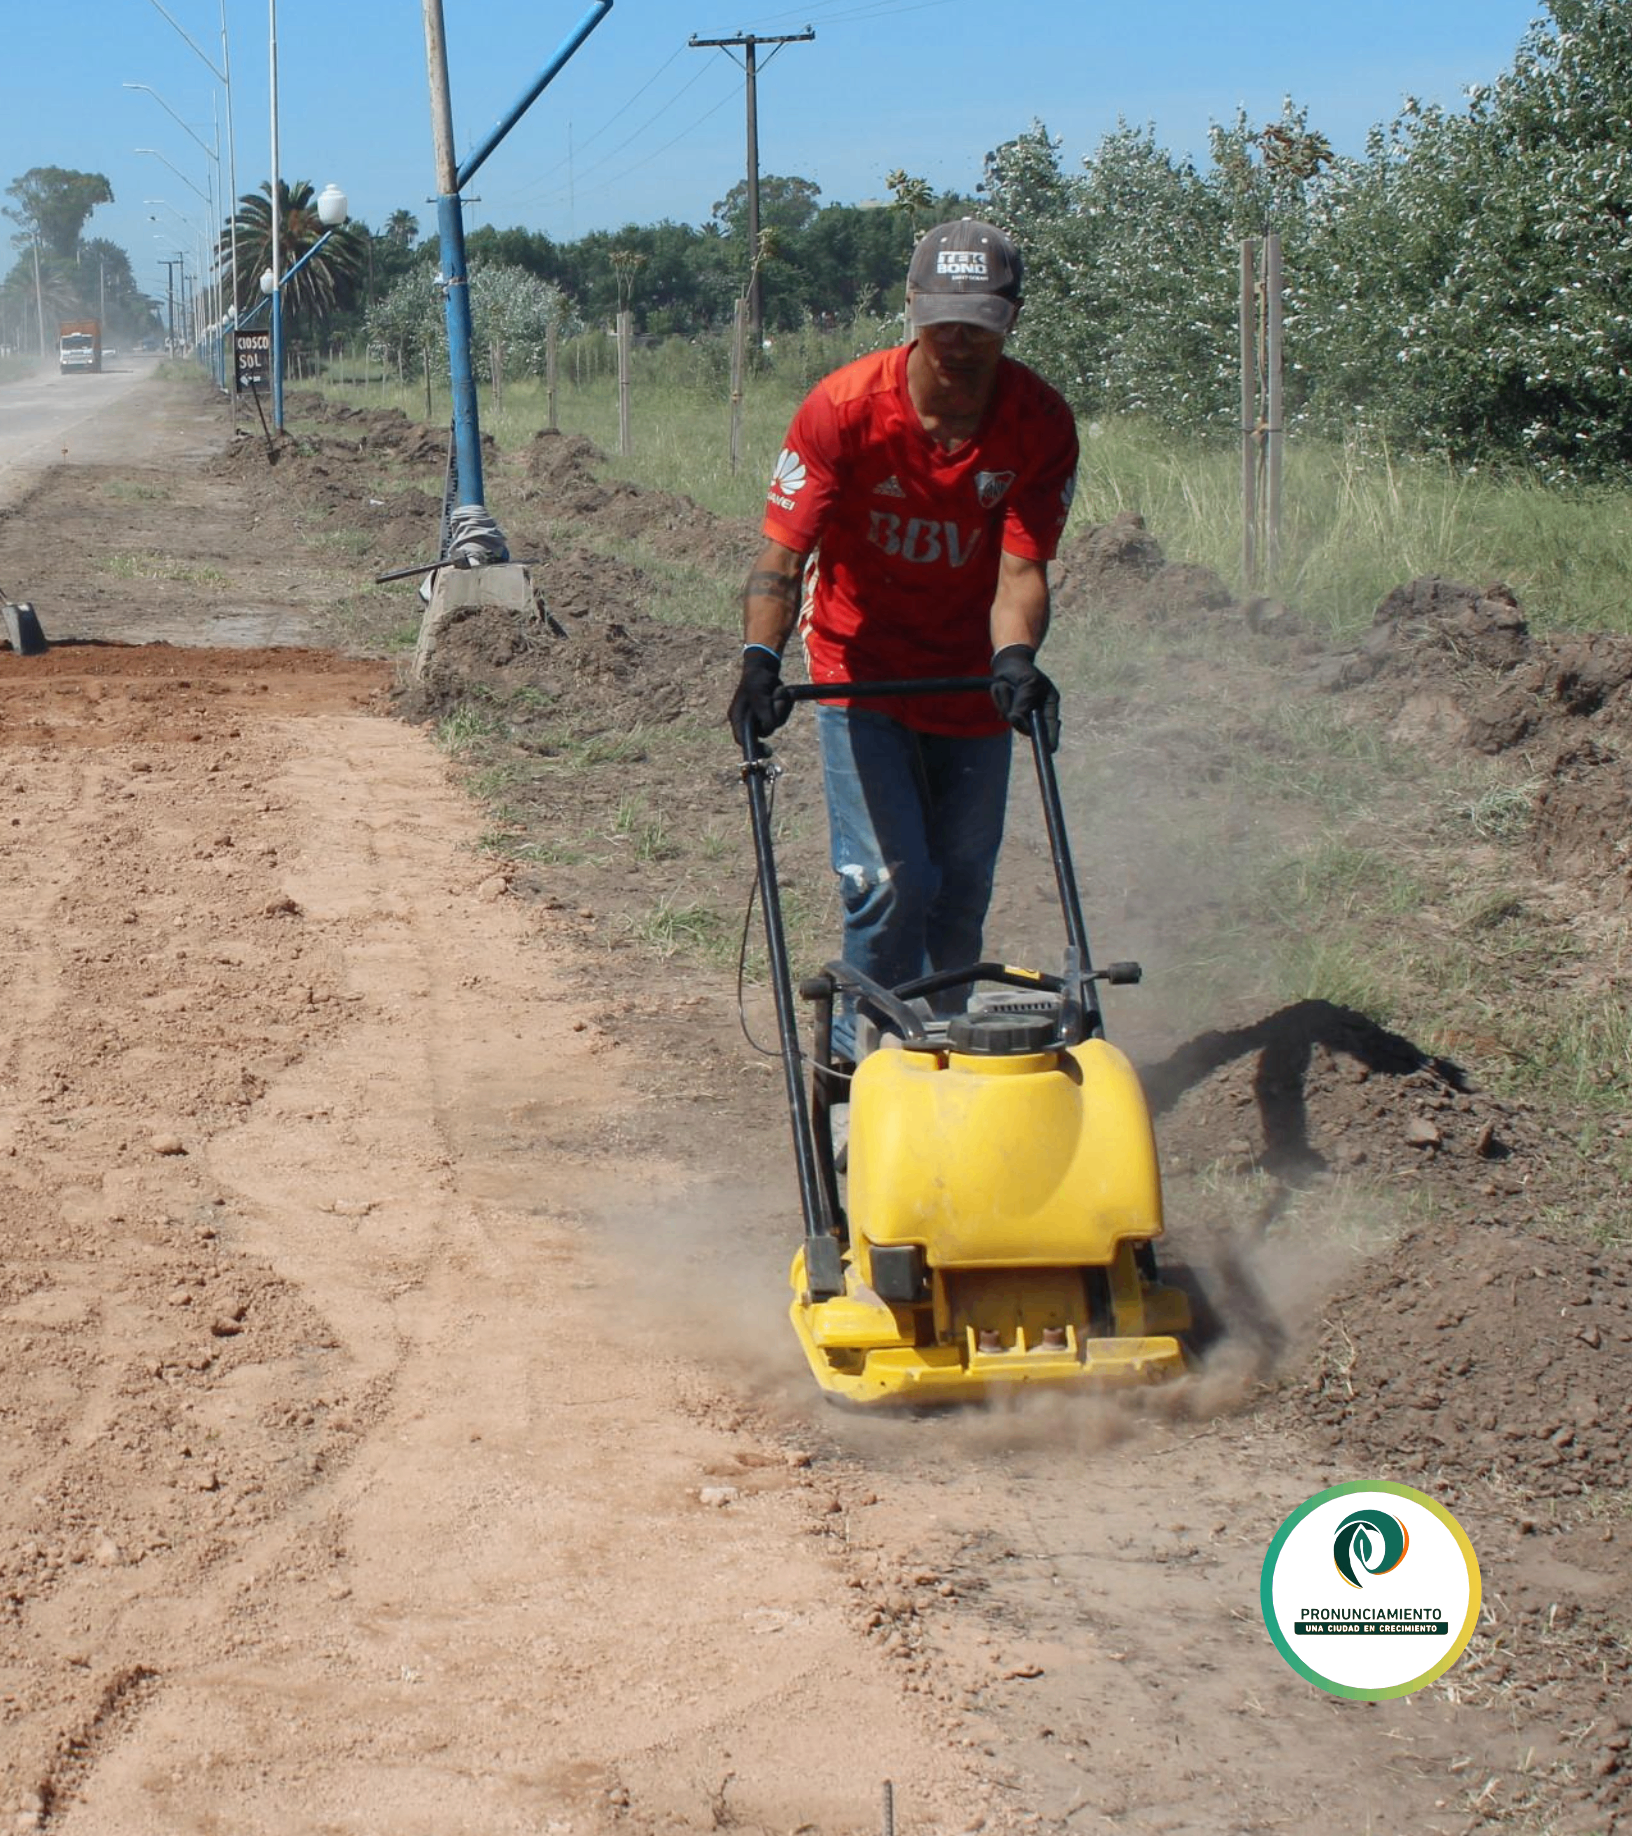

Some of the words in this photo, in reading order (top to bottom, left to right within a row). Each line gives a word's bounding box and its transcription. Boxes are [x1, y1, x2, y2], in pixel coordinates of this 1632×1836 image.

[938, 251, 986, 264] TEK
[937, 263, 987, 274] BOND
[239, 353, 262, 369] SOL
